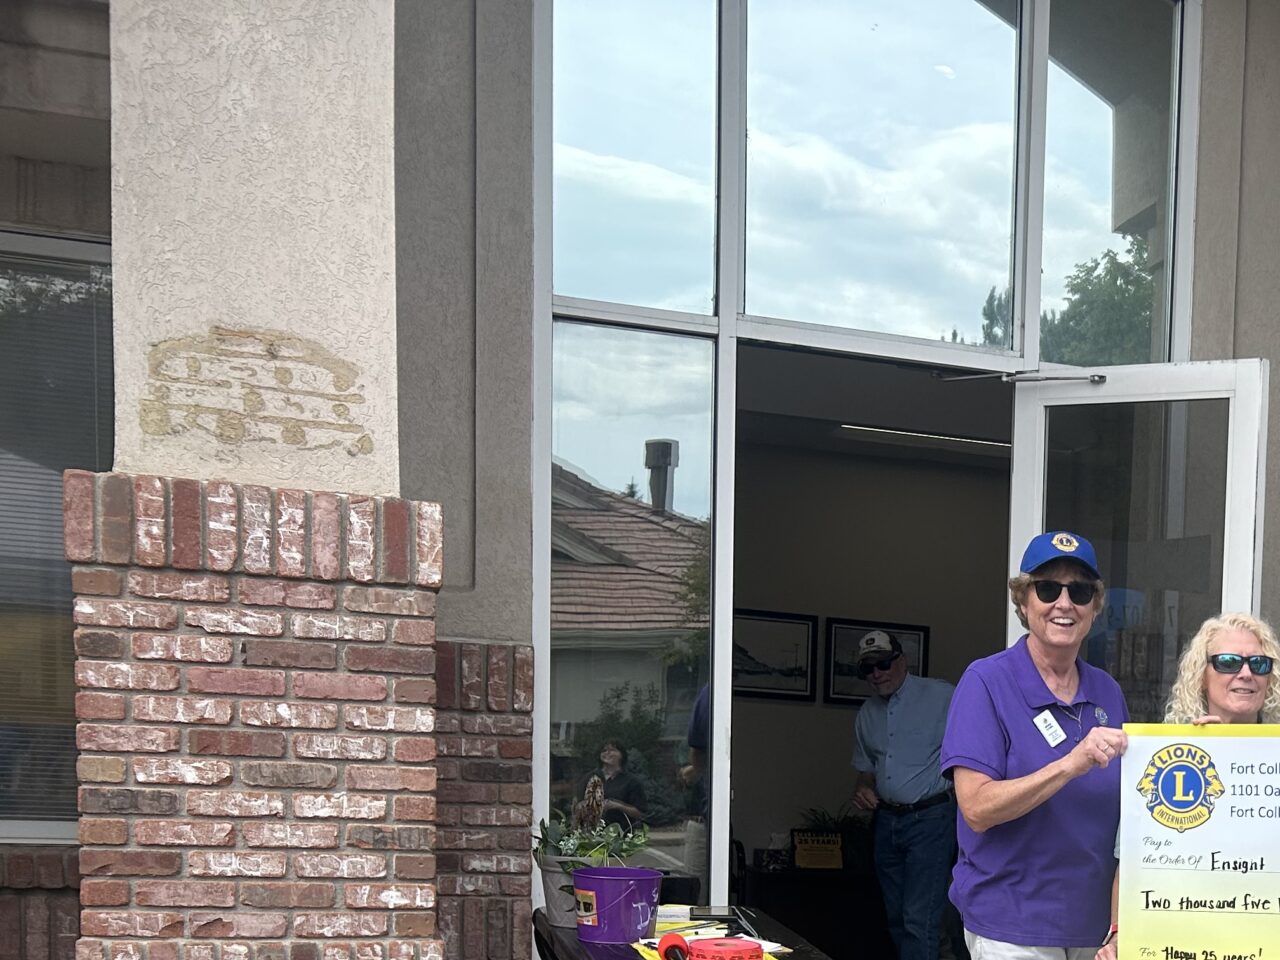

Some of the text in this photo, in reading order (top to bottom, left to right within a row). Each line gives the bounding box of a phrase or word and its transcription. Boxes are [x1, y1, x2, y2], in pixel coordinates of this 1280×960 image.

[1157, 746, 1207, 766] LIONS
[1230, 762, 1255, 776] Fort
[1172, 771, 1195, 801] L
[1230, 784, 1260, 797] 1101
[1156, 808, 1207, 826] INTERNATIONAL
[1230, 806, 1254, 819] Fort
[1142, 836, 1173, 850] Pay to
[1142, 854, 1203, 869] the Order Of
[1140, 890, 1171, 910] Two
[1179, 894, 1236, 910] thousand
[1241, 893, 1271, 911] five
[1139, 947, 1157, 958] For
